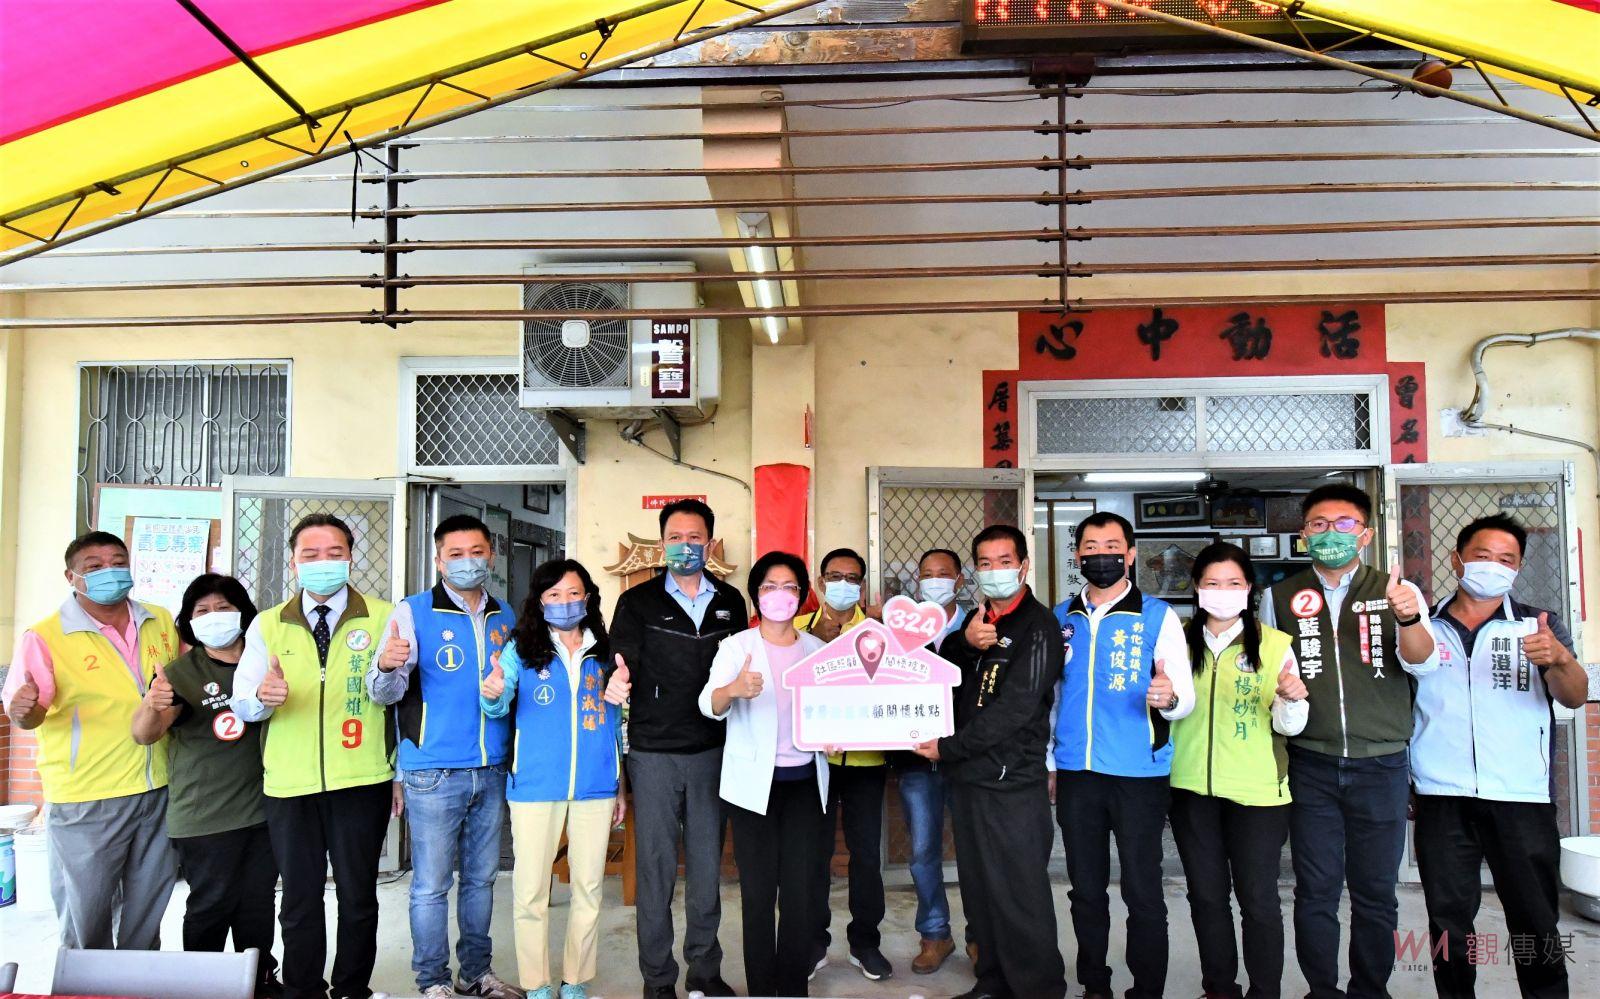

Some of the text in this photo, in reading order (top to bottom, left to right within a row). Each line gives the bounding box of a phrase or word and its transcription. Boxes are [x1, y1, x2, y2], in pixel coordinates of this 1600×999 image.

[654, 323, 688, 334] SAMPO
[1036, 307, 1361, 361] 活動中心
[889, 609, 937, 637] 324
[1299, 594, 1313, 613] 2
[83, 655, 100, 671] 2
[1108, 629, 1128, 692] 黃俊源
[1130, 622, 1144, 684] 彰化縣議員
[1297, 617, 1322, 679] 藍駿宇
[1491, 636, 1512, 690] 林澄洋
[345, 654, 364, 716] 葉國雄
[1232, 676, 1252, 740] 楊妙月
[222, 716, 237, 736] 2
[341, 718, 363, 749] 9
